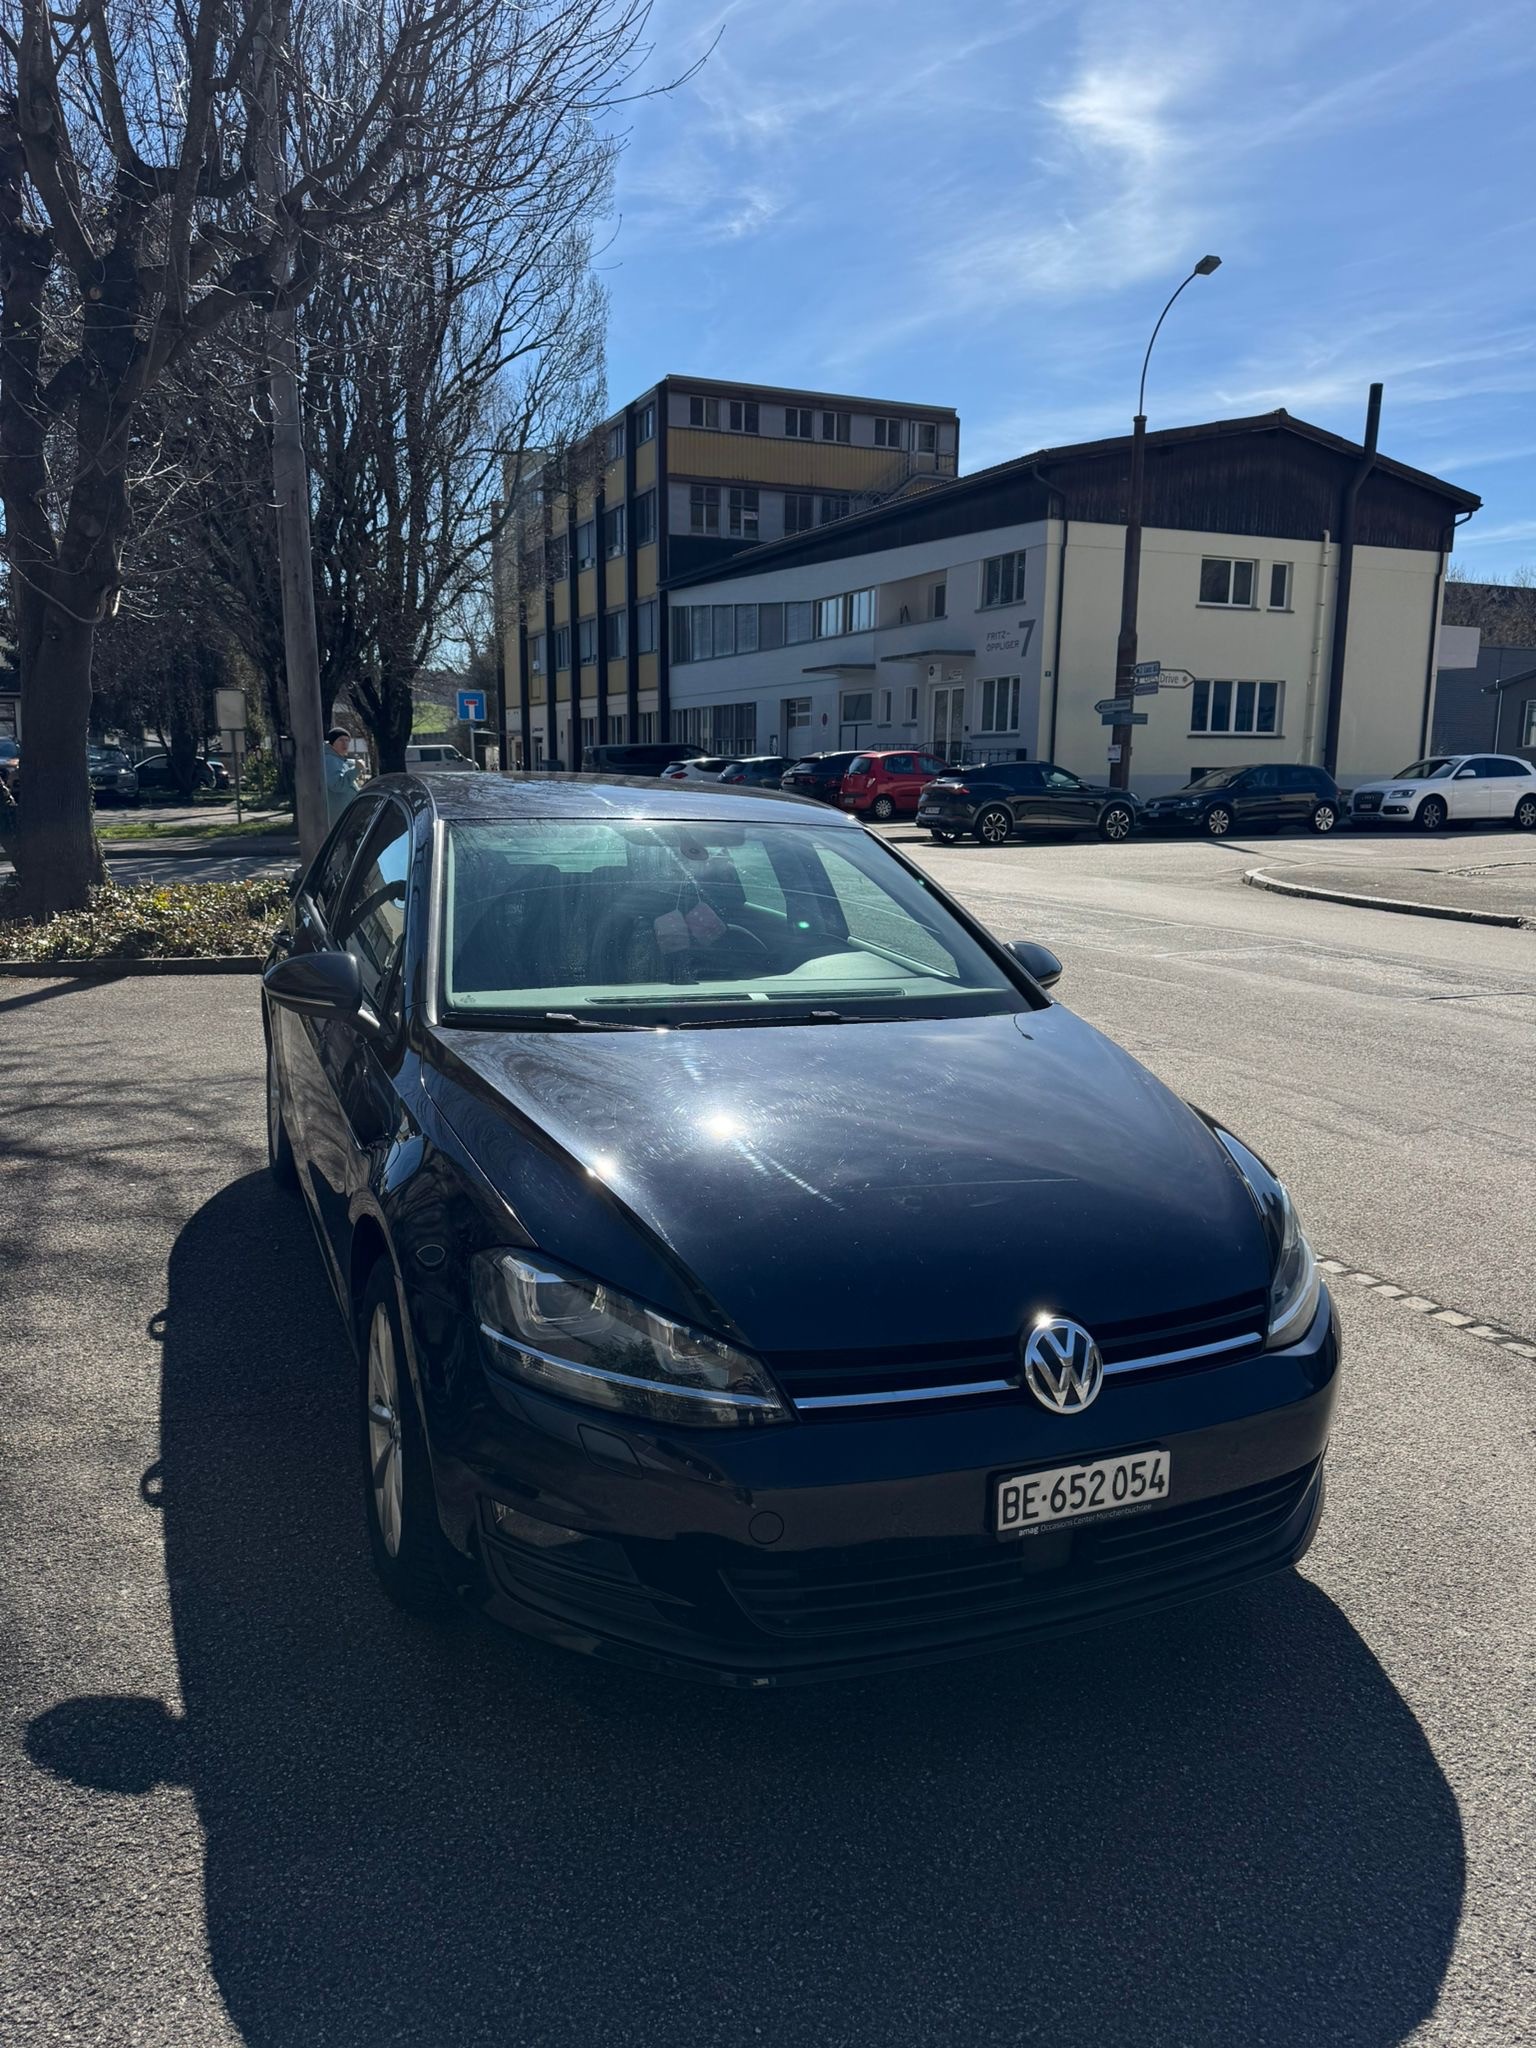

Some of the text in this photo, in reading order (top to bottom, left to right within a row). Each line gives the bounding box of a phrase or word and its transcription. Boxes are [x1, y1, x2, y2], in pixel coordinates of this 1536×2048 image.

[1018, 618, 1036, 657] 7
[1160, 673, 1179, 684] Drive
[1018, 1526, 1039, 1537] amag
[1074, 1513, 1095, 1526] Center
